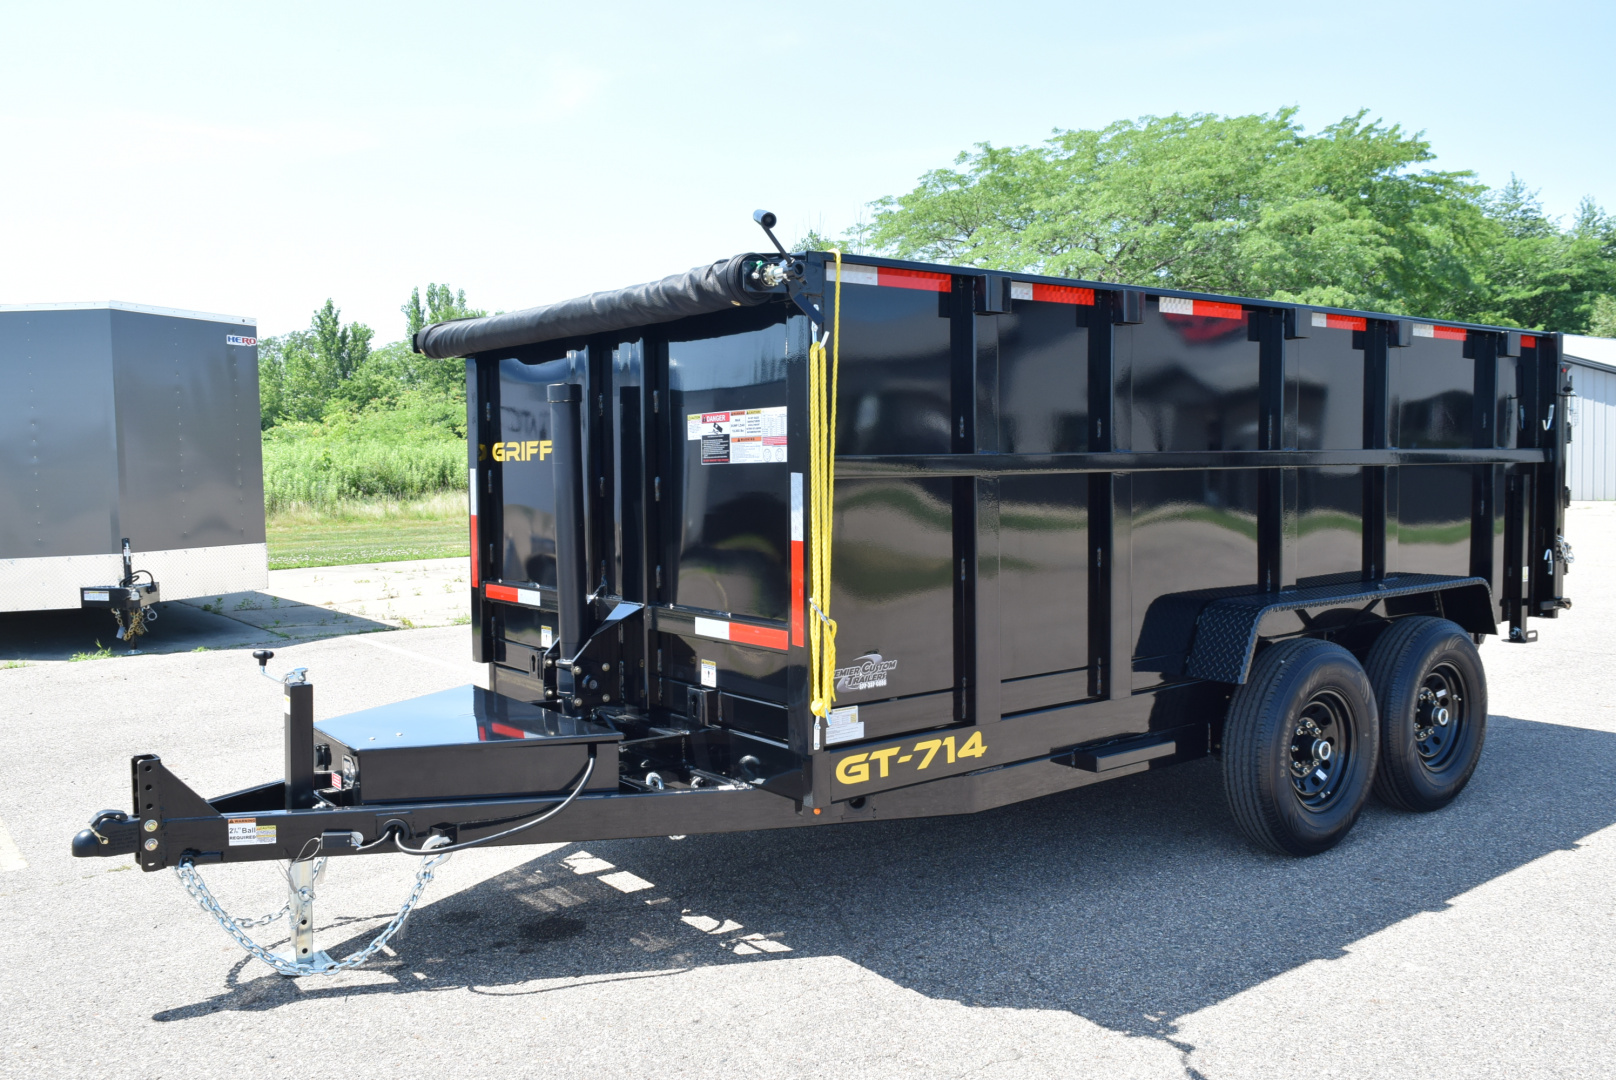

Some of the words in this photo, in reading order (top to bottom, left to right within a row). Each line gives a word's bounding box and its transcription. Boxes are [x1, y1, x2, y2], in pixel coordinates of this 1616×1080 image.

[227, 336, 256, 345] HERO
[491, 440, 553, 462] GRIFF
[835, 666, 860, 678] EMIER
[861, 660, 897, 674] CUSTOM
[847, 672, 887, 687] TRAILERS
[835, 731, 988, 785] GT-714
